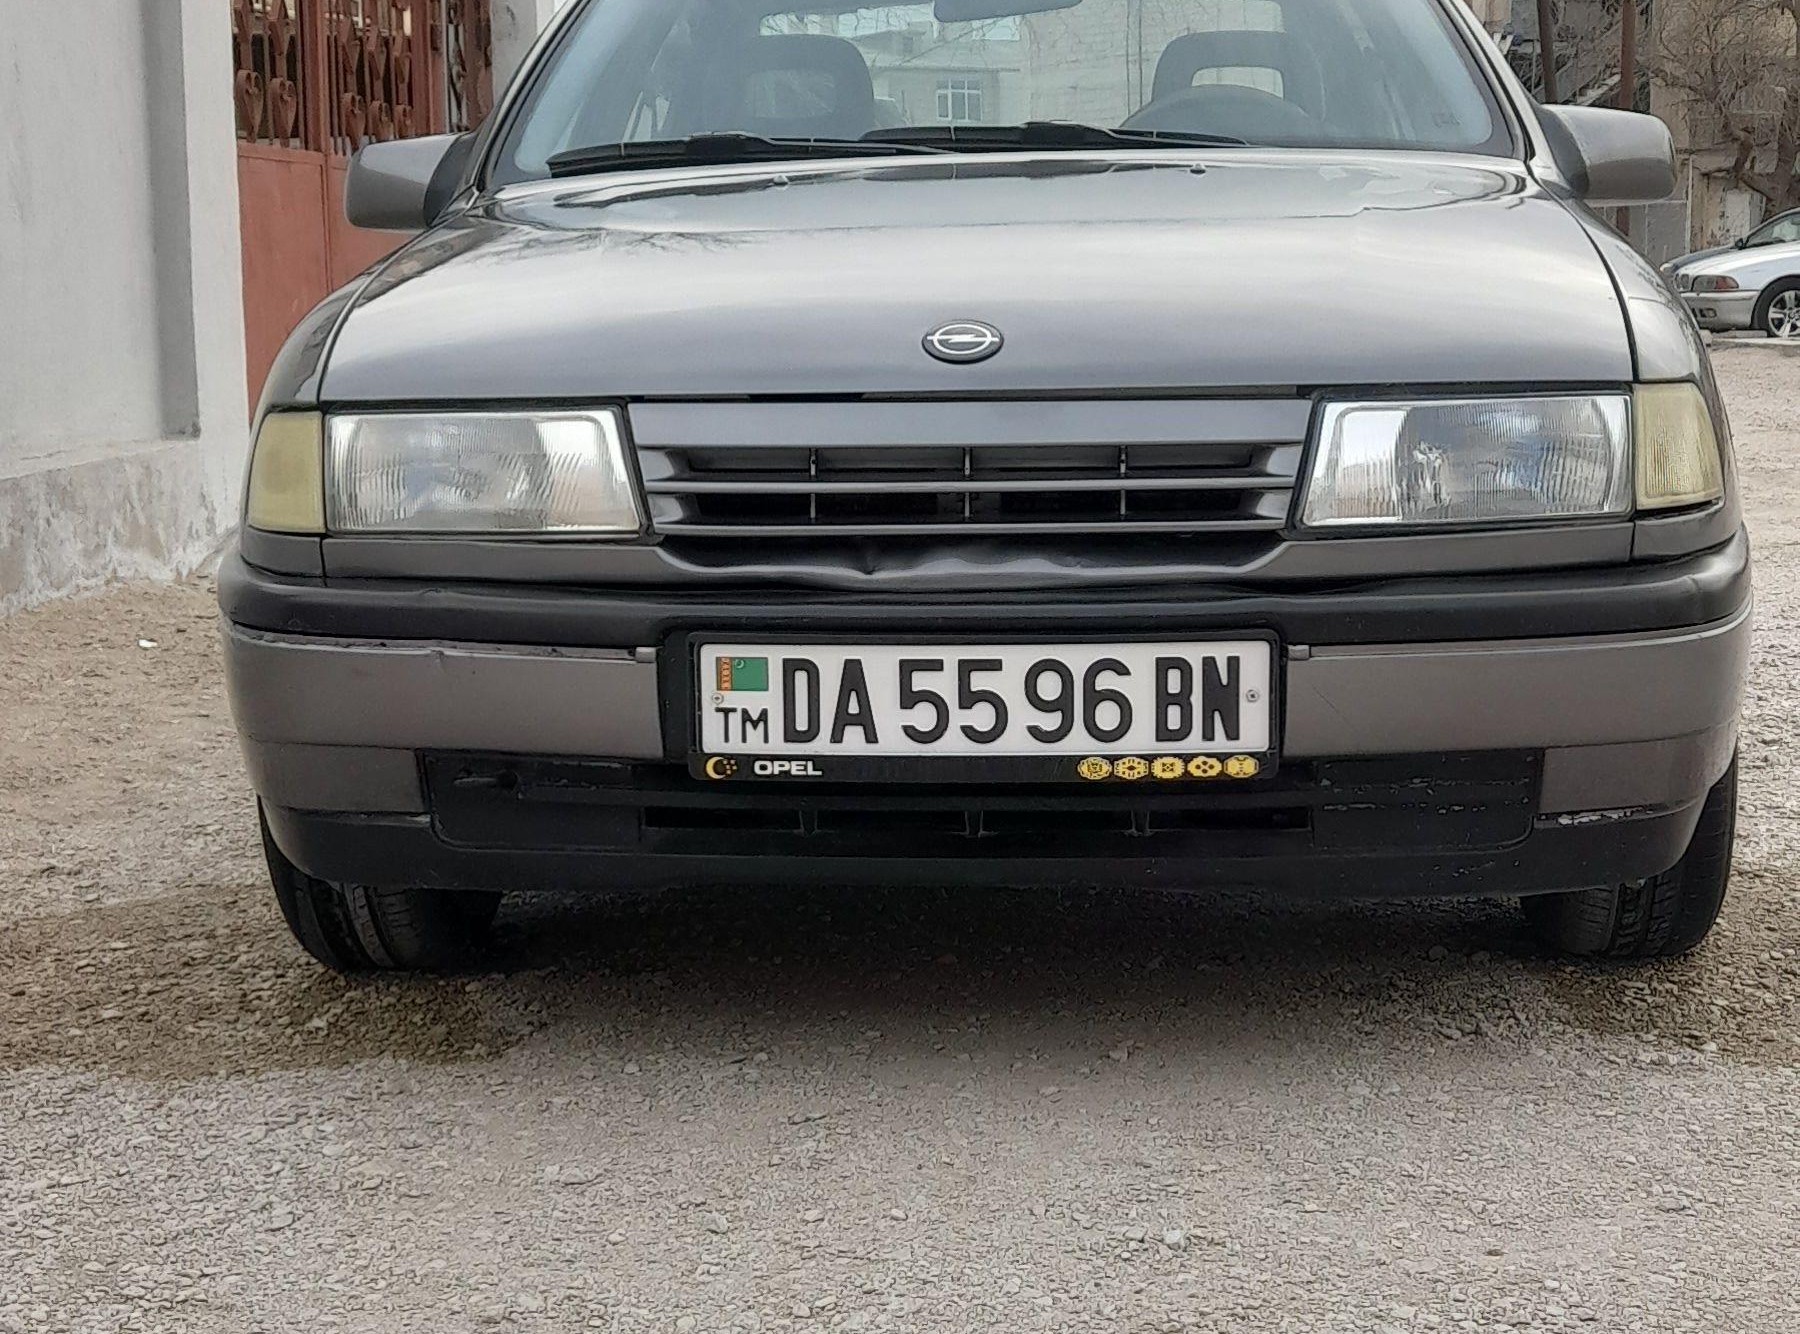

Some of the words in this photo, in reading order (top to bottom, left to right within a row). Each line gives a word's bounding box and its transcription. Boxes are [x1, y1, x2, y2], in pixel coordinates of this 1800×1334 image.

[782, 657, 879, 744] DA
[1154, 655, 1241, 741] BN
[714, 707, 770, 745] TM
[754, 760, 823, 776] OPEL
